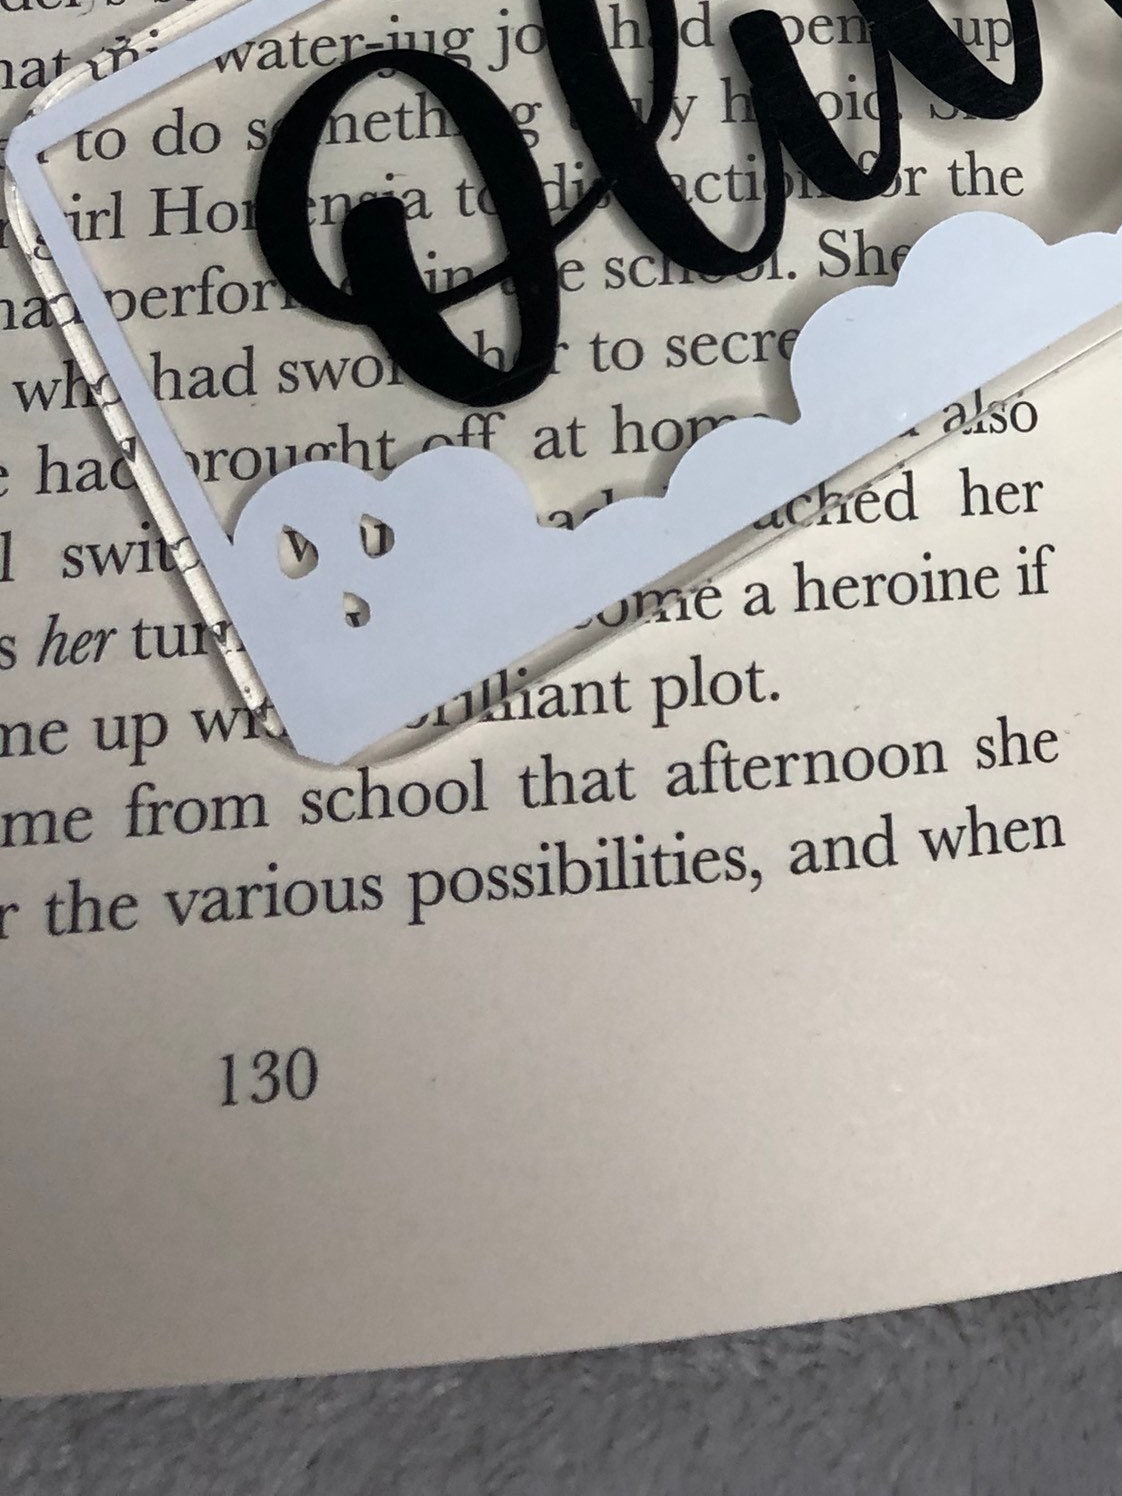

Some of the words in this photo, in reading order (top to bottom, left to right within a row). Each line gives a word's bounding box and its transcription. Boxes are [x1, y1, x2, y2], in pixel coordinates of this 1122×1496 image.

[947, 149, 1024, 197] the
[149, 344, 258, 401] had
[958, 466, 1044, 517] her
[792, 551, 1000, 613] heroine
[1016, 543, 1056, 596] if
[36, 612, 118, 667] her
[650, 654, 780, 729] plot.
[92, 711, 169, 767] up
[125, 781, 270, 838] from
[301, 757, 489, 825] school
[518, 752, 637, 809] that
[666, 739, 949, 798] afternoon
[976, 714, 1059, 770] she
[44, 878, 139, 937] the
[163, 862, 384, 927] various
[407, 830, 763, 926] possibilities,
[789, 812, 899, 876] and
[918, 803, 1067, 862] when
[221, 1046, 319, 1107] 130
